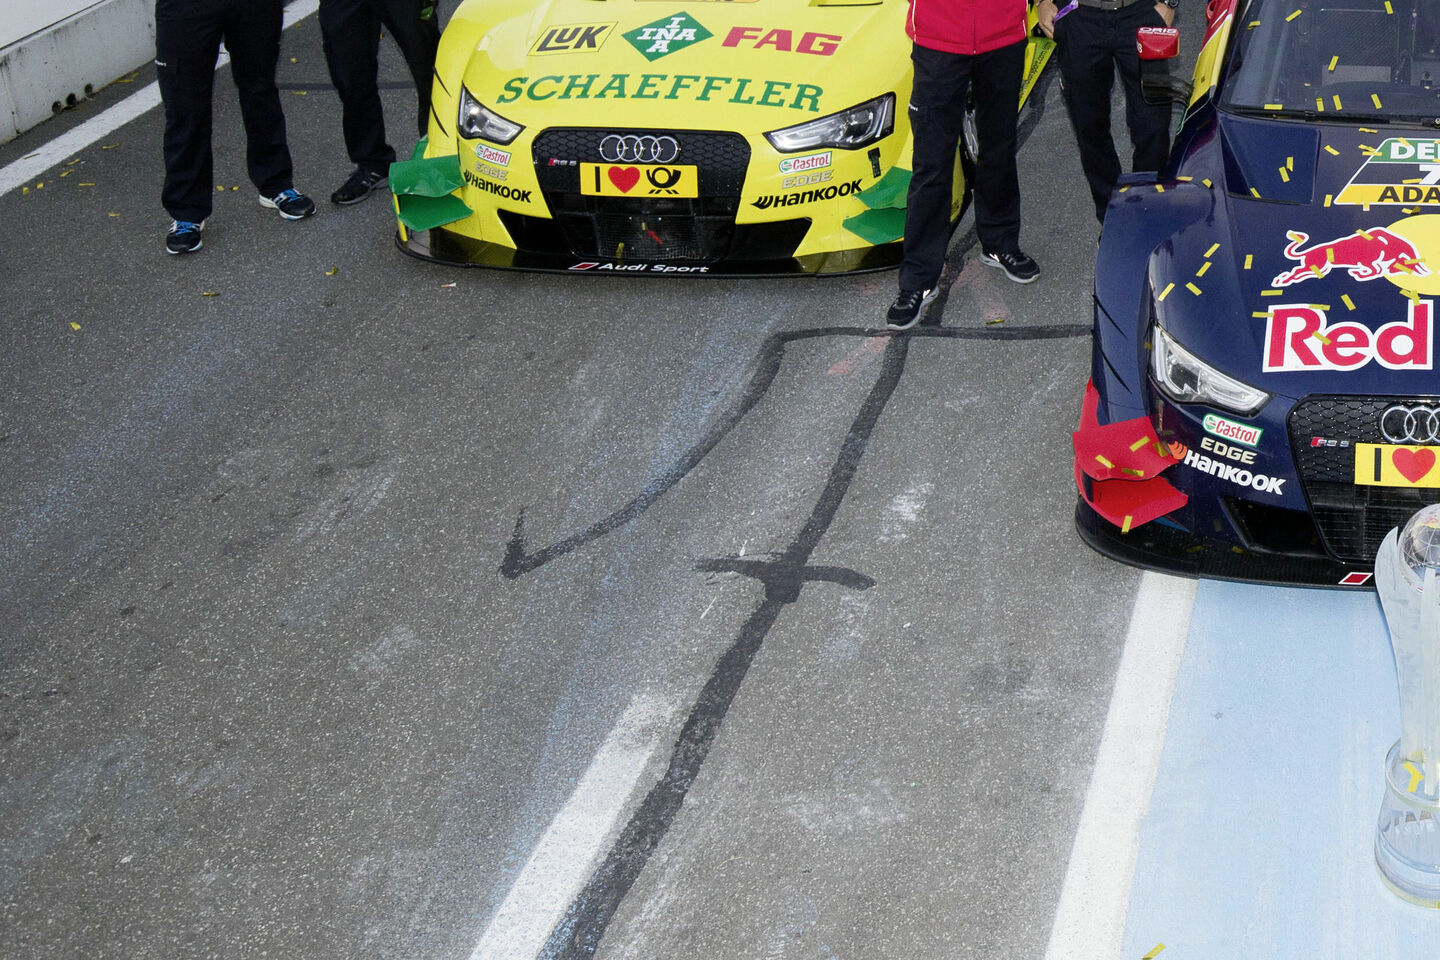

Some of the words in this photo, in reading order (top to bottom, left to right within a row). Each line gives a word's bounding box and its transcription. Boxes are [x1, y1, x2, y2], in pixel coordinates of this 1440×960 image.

[721, 26, 842, 56] FAG
[496, 73, 824, 113] SCHAEFFLER
[482, 147, 509, 164] Castrol
[792, 154, 829, 170] Castrol
[475, 162, 509, 181] EDGE
[782, 169, 834, 189] EDGE
[598, 262, 649, 273] Audi
[652, 263, 709, 275] Sport
[1262, 299, 1434, 372] Red
[1216, 420, 1259, 444] Castrol
[1200, 437, 1257, 465] EDGE
